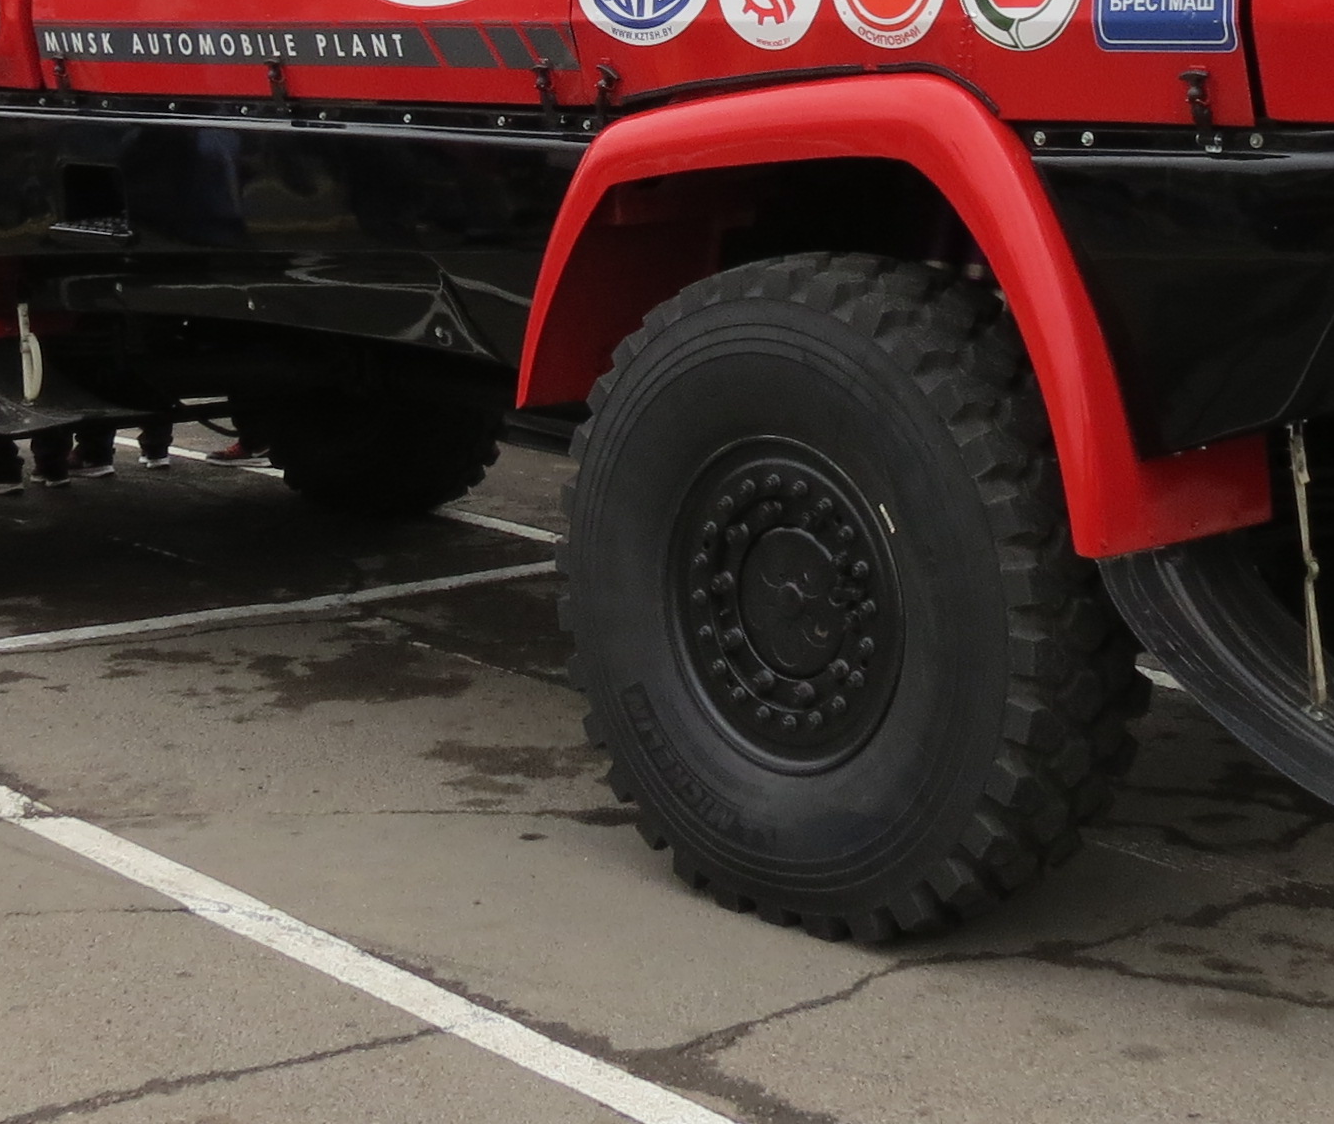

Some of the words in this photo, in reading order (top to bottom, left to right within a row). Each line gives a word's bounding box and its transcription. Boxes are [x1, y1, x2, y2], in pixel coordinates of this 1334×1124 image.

[44, 31, 114, 55] MINSK
[132, 32, 297, 57] AUTOMOBILE
[317, 32, 406, 58] PLANT
